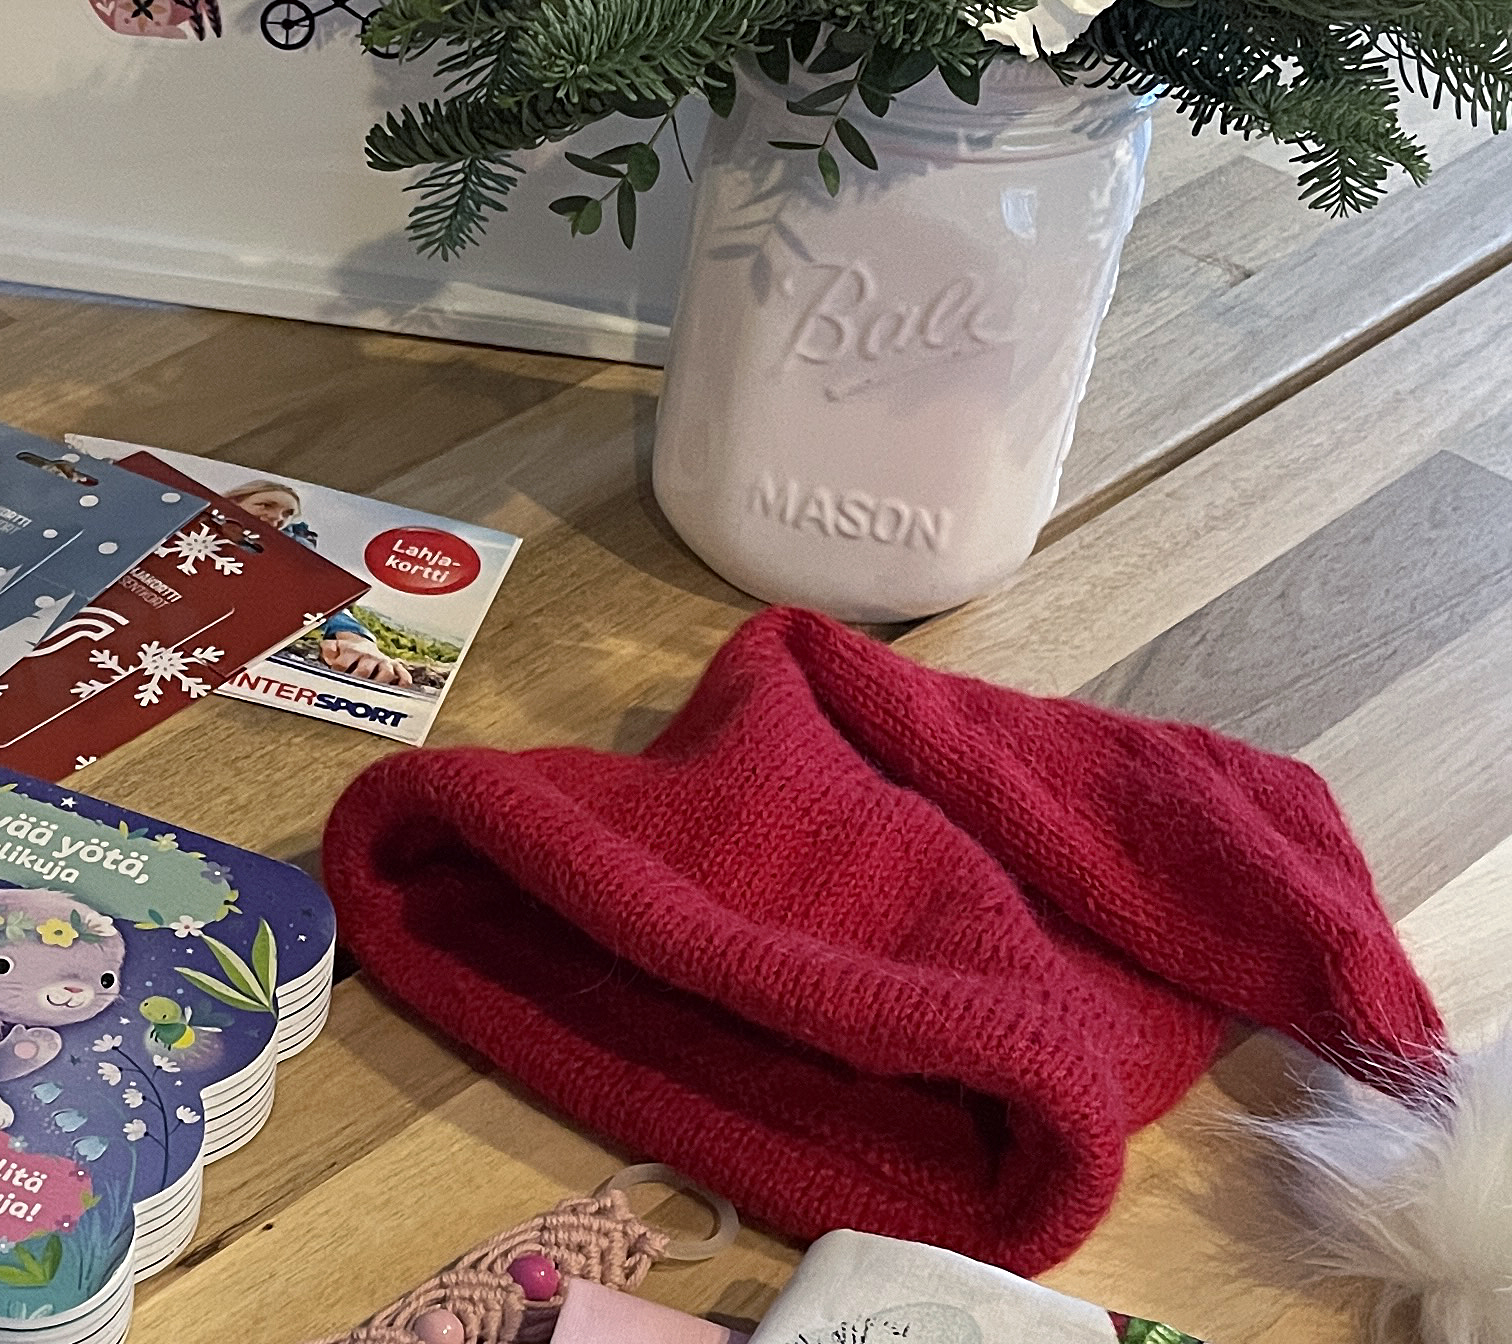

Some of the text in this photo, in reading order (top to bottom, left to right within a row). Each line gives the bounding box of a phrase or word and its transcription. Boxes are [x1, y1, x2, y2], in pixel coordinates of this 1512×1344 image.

[748, 468, 951, 554] MASON
[385, 554, 451, 584] kortti
[392, 539, 462, 569] Lahja-
[52, 834, 151, 884] yötä,
